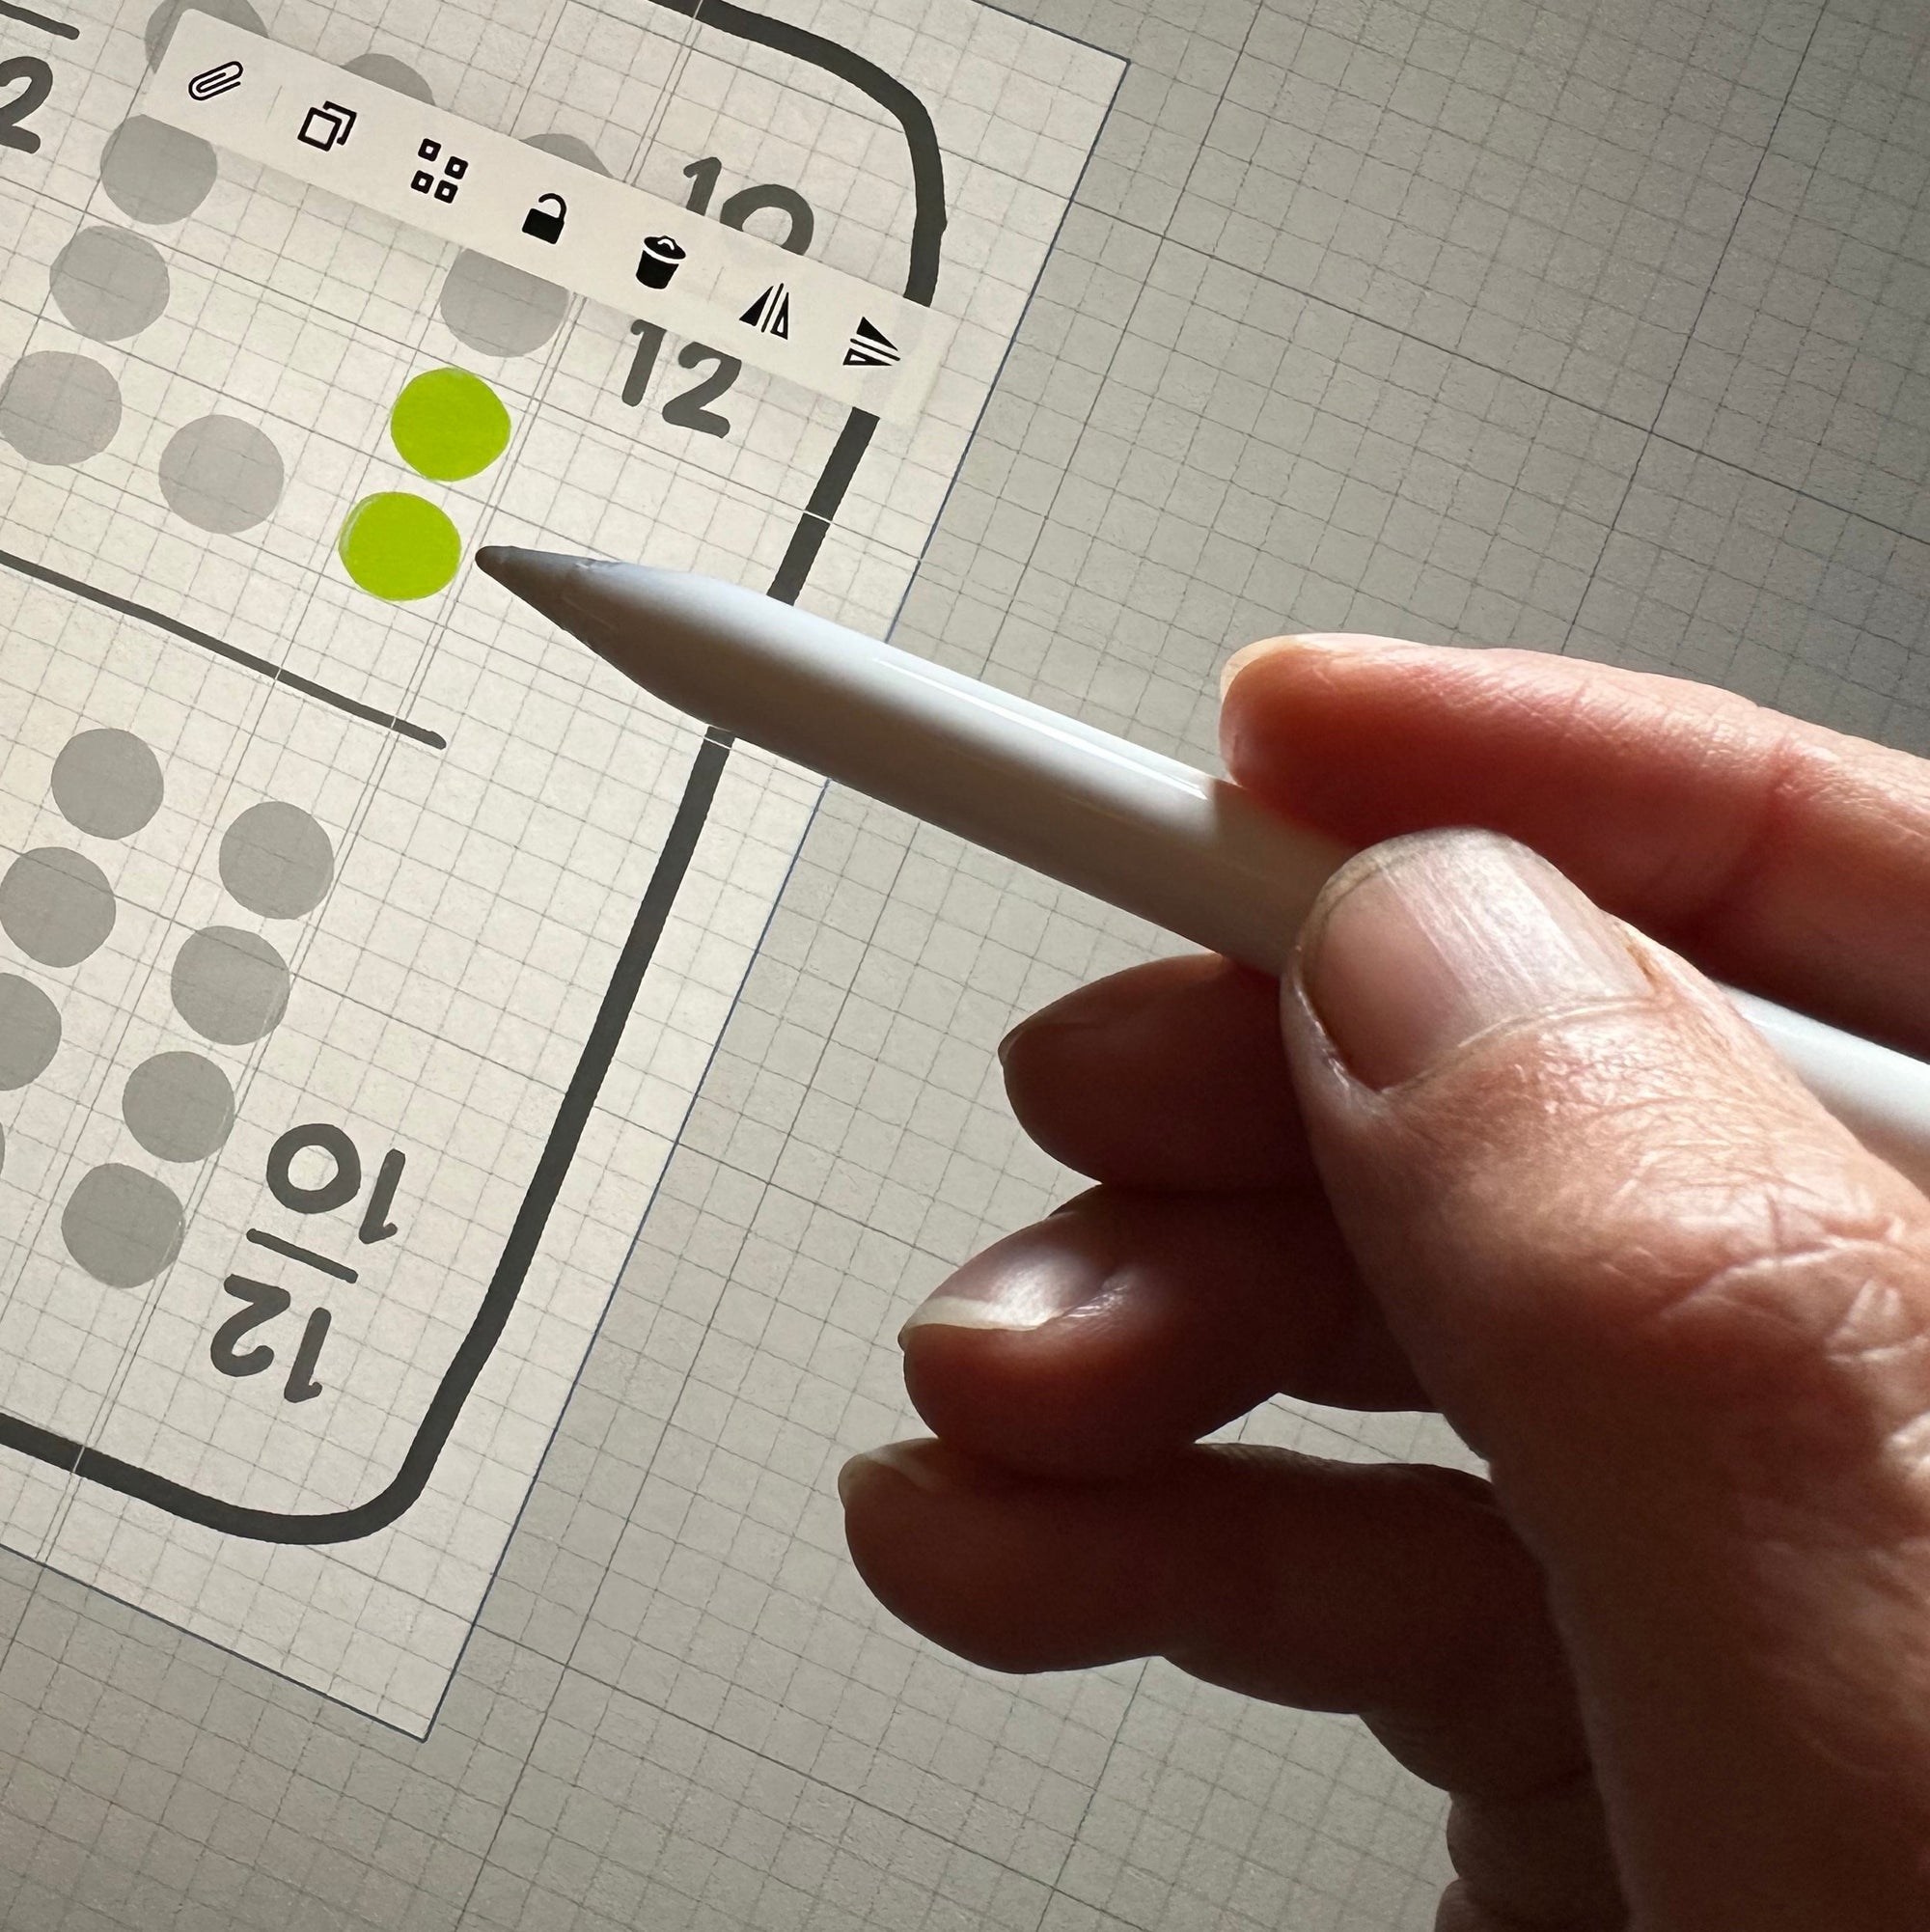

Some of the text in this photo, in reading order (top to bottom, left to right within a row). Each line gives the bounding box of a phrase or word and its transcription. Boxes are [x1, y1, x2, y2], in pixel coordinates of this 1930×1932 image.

[622, 318, 741, 439] 12
[266, 1123, 406, 1245] 10
[209, 1273, 332, 1404] 12
